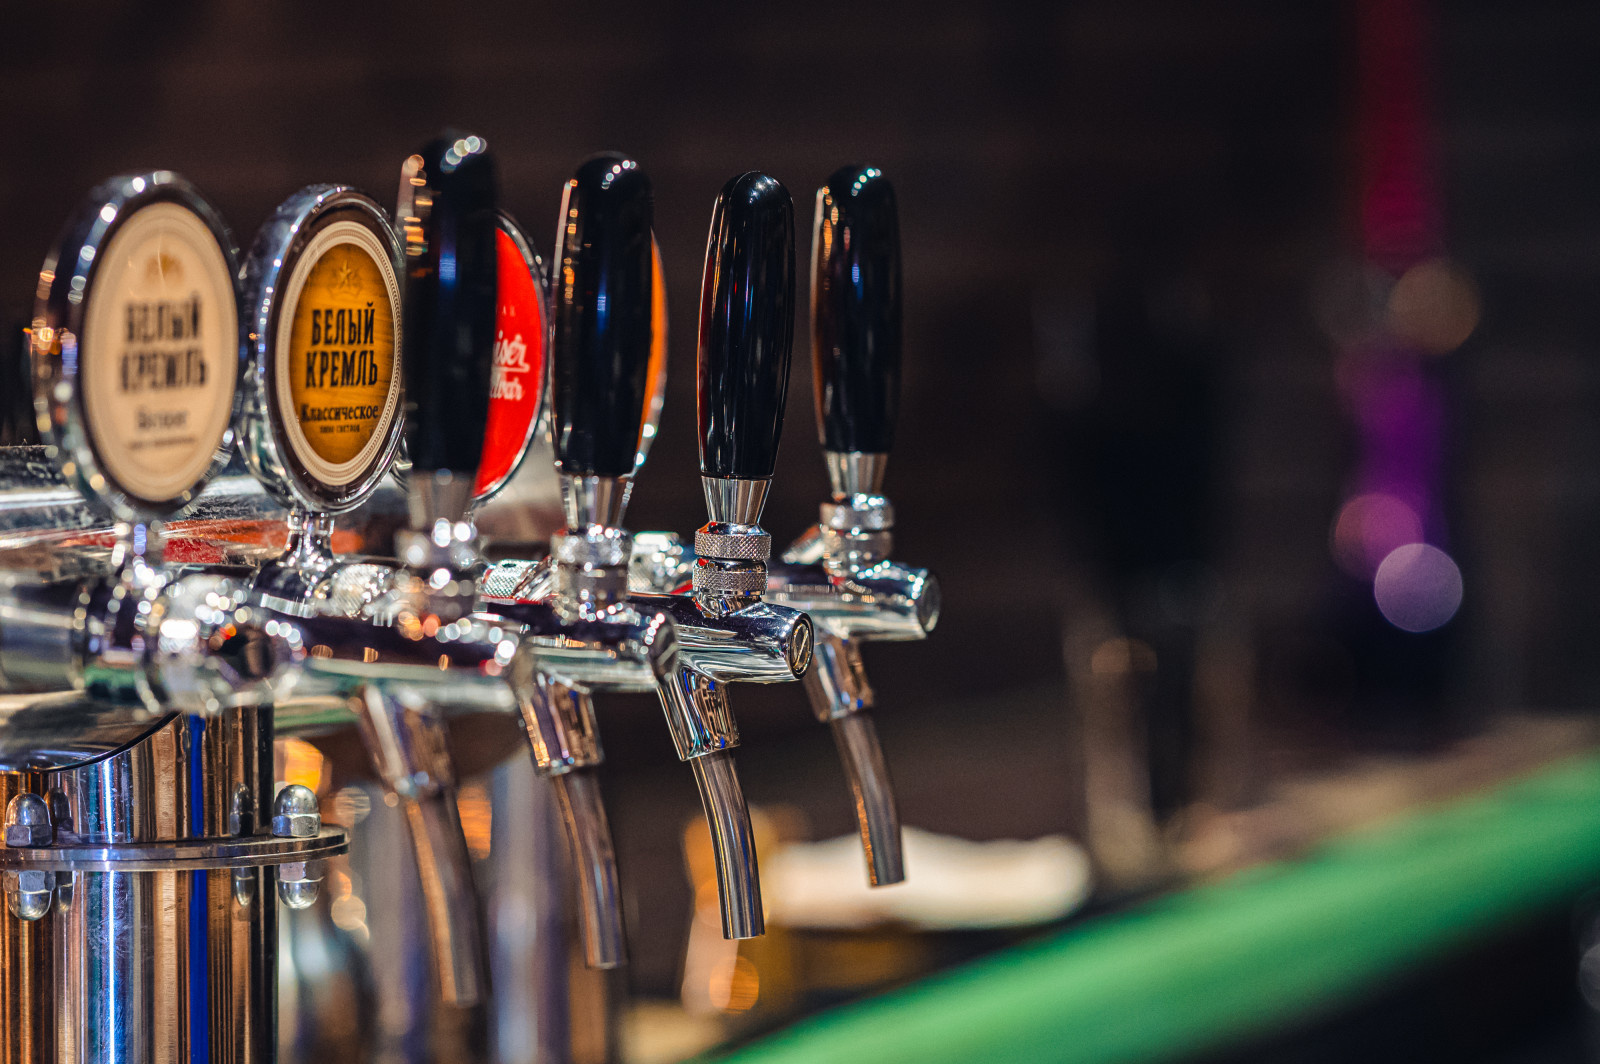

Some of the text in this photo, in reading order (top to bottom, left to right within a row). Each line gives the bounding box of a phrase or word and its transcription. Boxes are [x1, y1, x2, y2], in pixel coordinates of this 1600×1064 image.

[311, 301, 375, 346] БЕЛЫЙ
[305, 350, 378, 388] КРЕМЛЬ
[301, 403, 379, 423] Классическое
